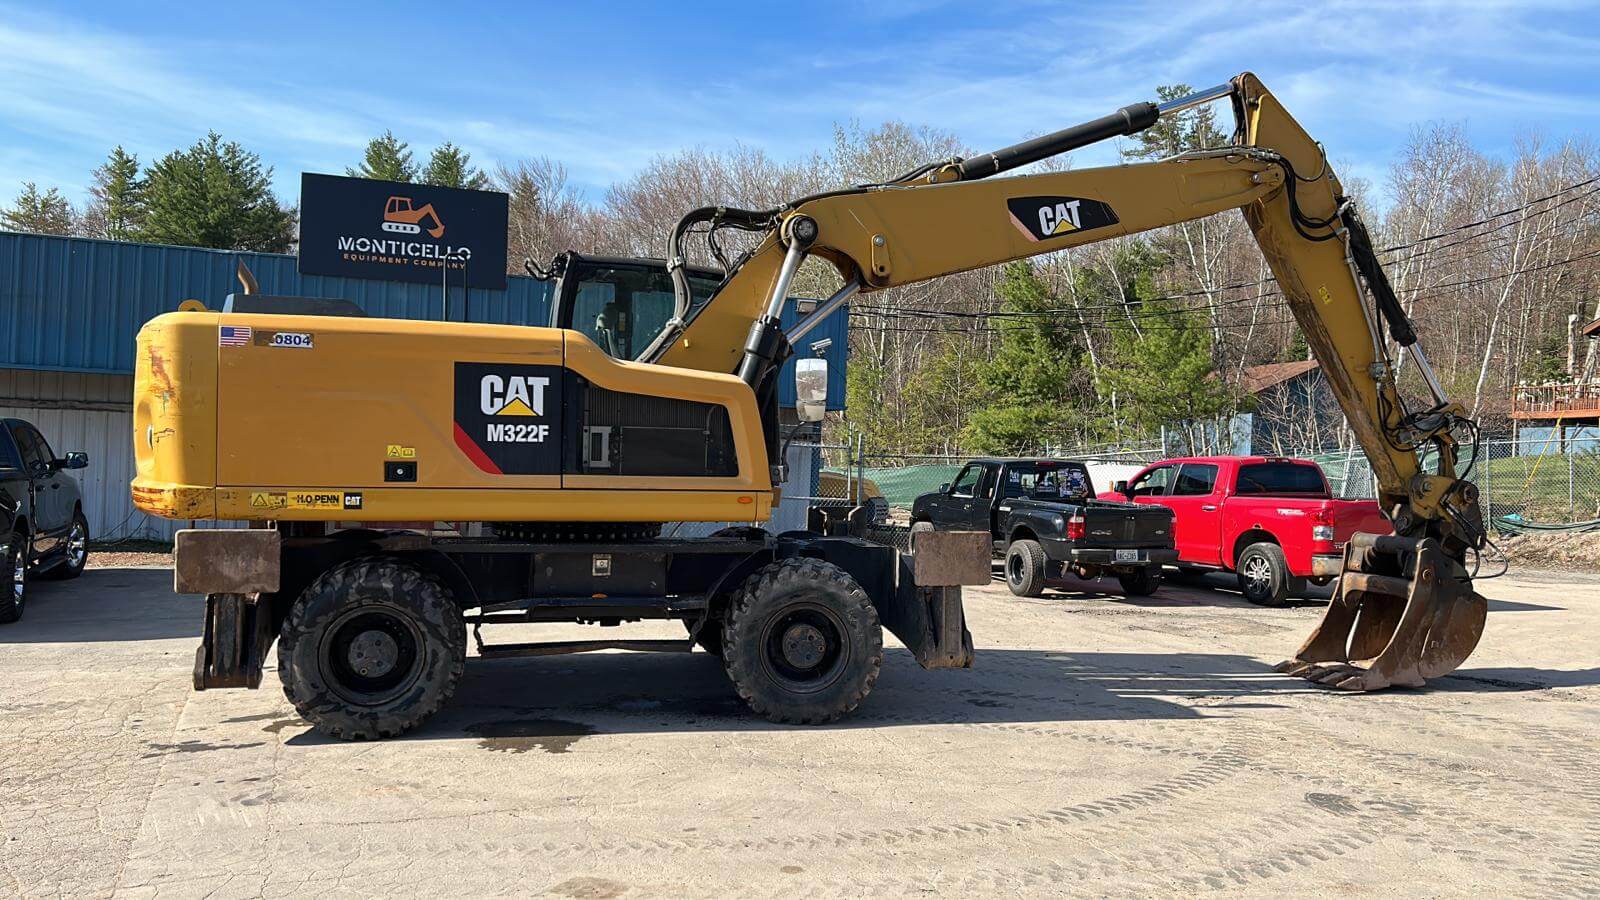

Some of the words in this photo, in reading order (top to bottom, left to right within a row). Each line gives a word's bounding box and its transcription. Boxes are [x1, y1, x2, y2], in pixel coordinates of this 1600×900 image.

[1039, 200, 1081, 236] CAT
[338, 236, 471, 261] MONTICELLO
[343, 253, 409, 265] EQUIPMENT
[275, 335, 311, 346] 0804
[481, 374, 550, 417] CAT
[487, 423, 550, 443] M322F
[315, 494, 340, 504] PENN
[345, 496, 361, 506] CAT
